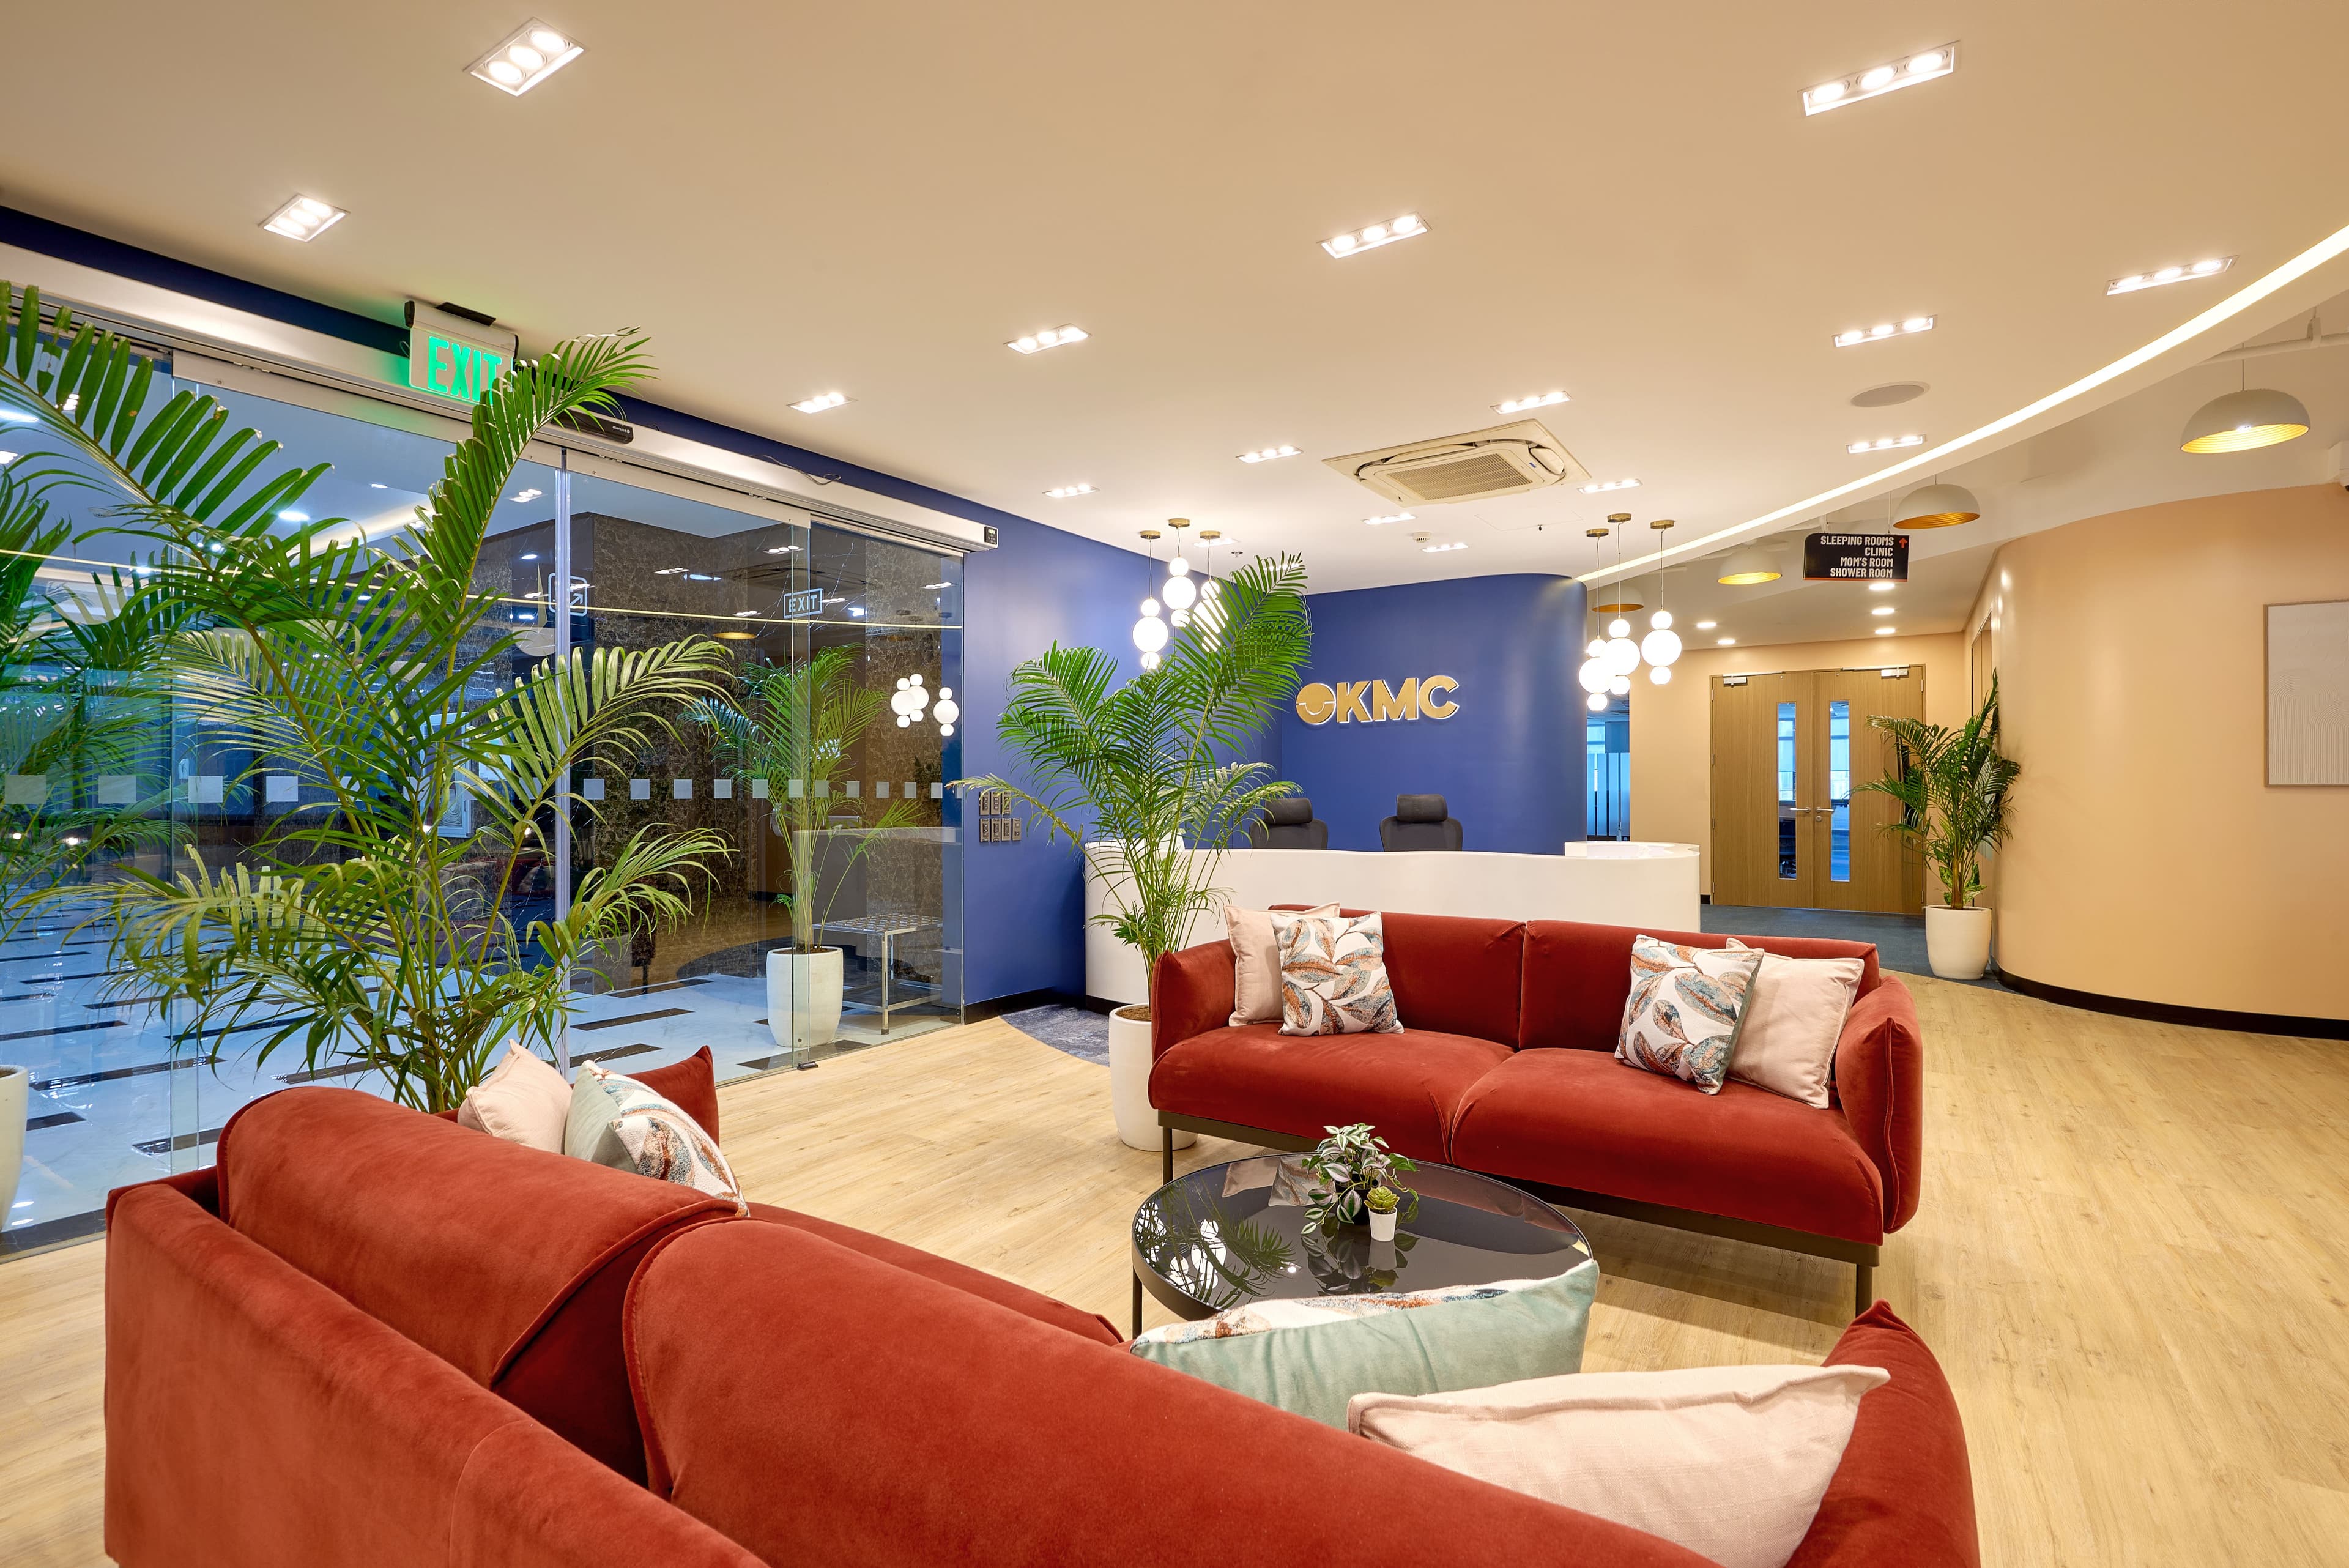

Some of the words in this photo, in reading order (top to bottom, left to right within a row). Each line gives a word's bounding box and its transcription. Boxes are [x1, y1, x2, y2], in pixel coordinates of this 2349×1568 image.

[428, 336, 502, 406] EXIT
[1820, 536, 1863, 545] SLEEPING
[1865, 537, 1894, 546] ROOMS
[1865, 547, 1893, 557] CLINIC
[1840, 557, 1868, 567] MOM'S
[1869, 558, 1893, 567] ROOM
[1830, 568, 1867, 577] SHOWER
[1869, 568, 1893, 578] ROOM
[789, 594, 818, 613] EXIT
